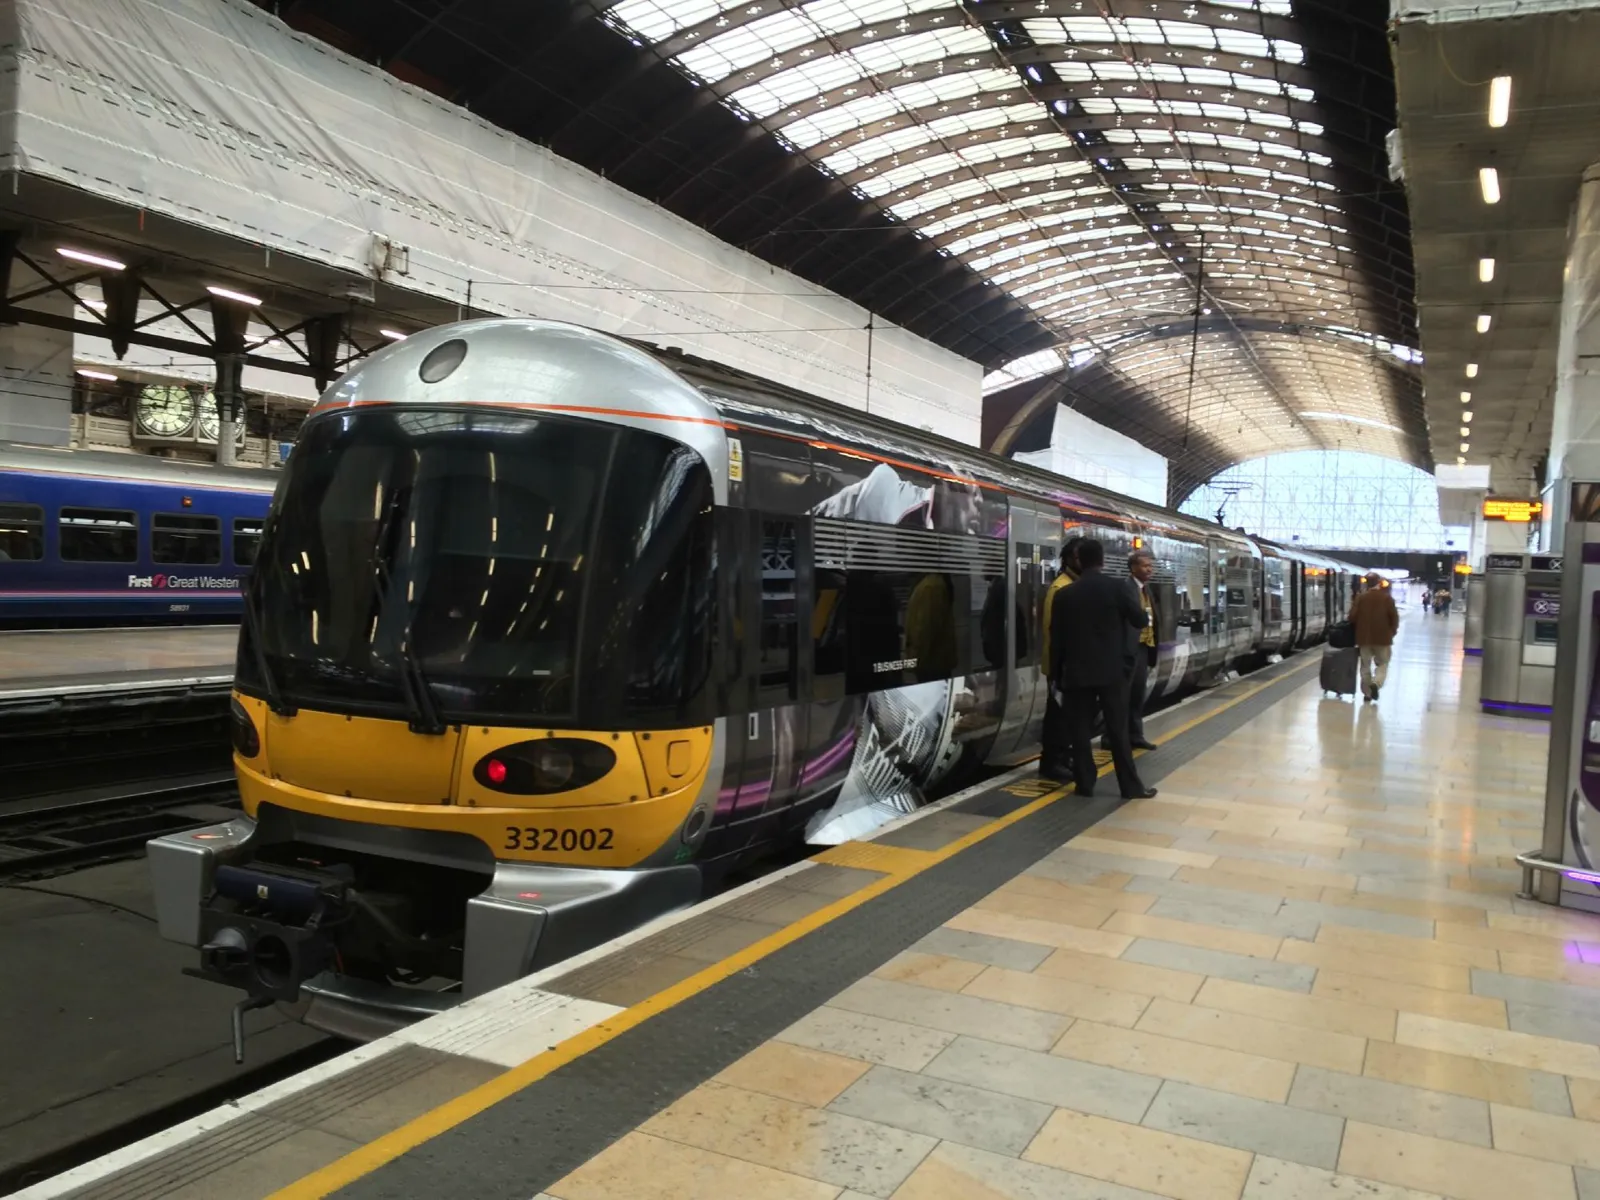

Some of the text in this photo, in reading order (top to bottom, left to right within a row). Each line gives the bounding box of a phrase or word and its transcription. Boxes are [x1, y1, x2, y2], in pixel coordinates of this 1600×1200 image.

[128, 575, 153, 588] First
[167, 575, 198, 588] Great
[504, 826, 614, 851] 332002
